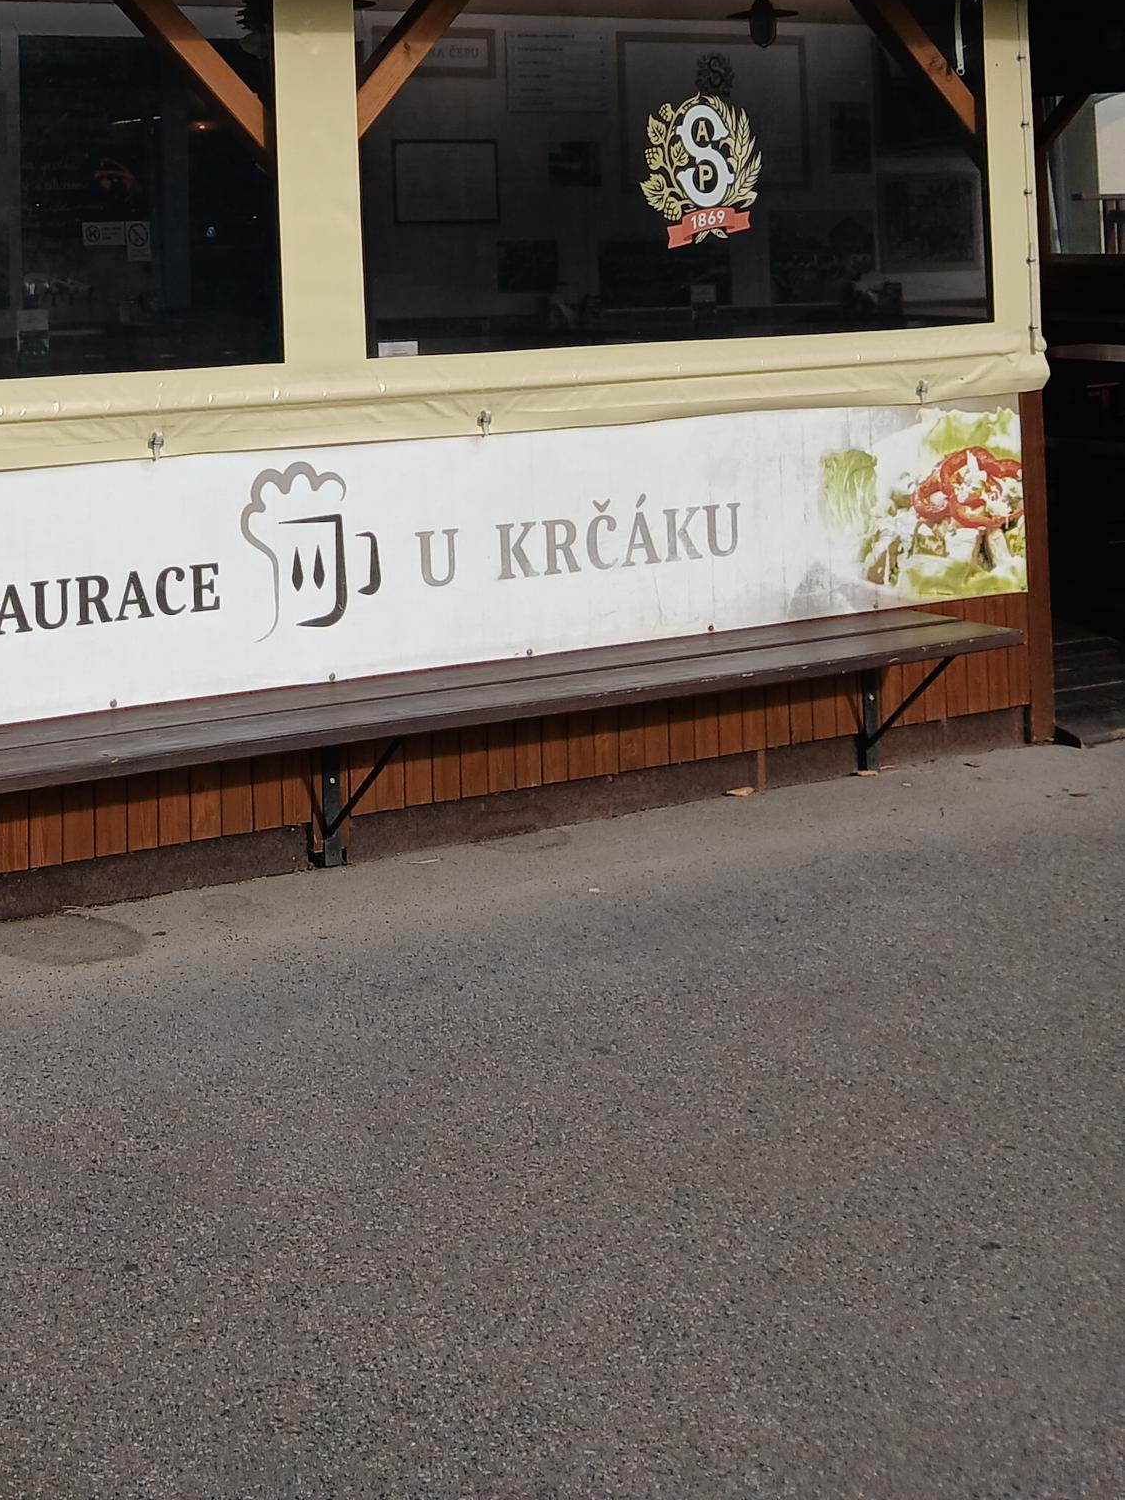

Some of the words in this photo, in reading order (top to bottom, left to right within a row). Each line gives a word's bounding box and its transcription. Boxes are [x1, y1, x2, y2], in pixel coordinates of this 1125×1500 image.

[691, 210, 726, 230] 1869
[416, 528, 459, 587] U
[495, 493, 743, 581] KRČÁKU
